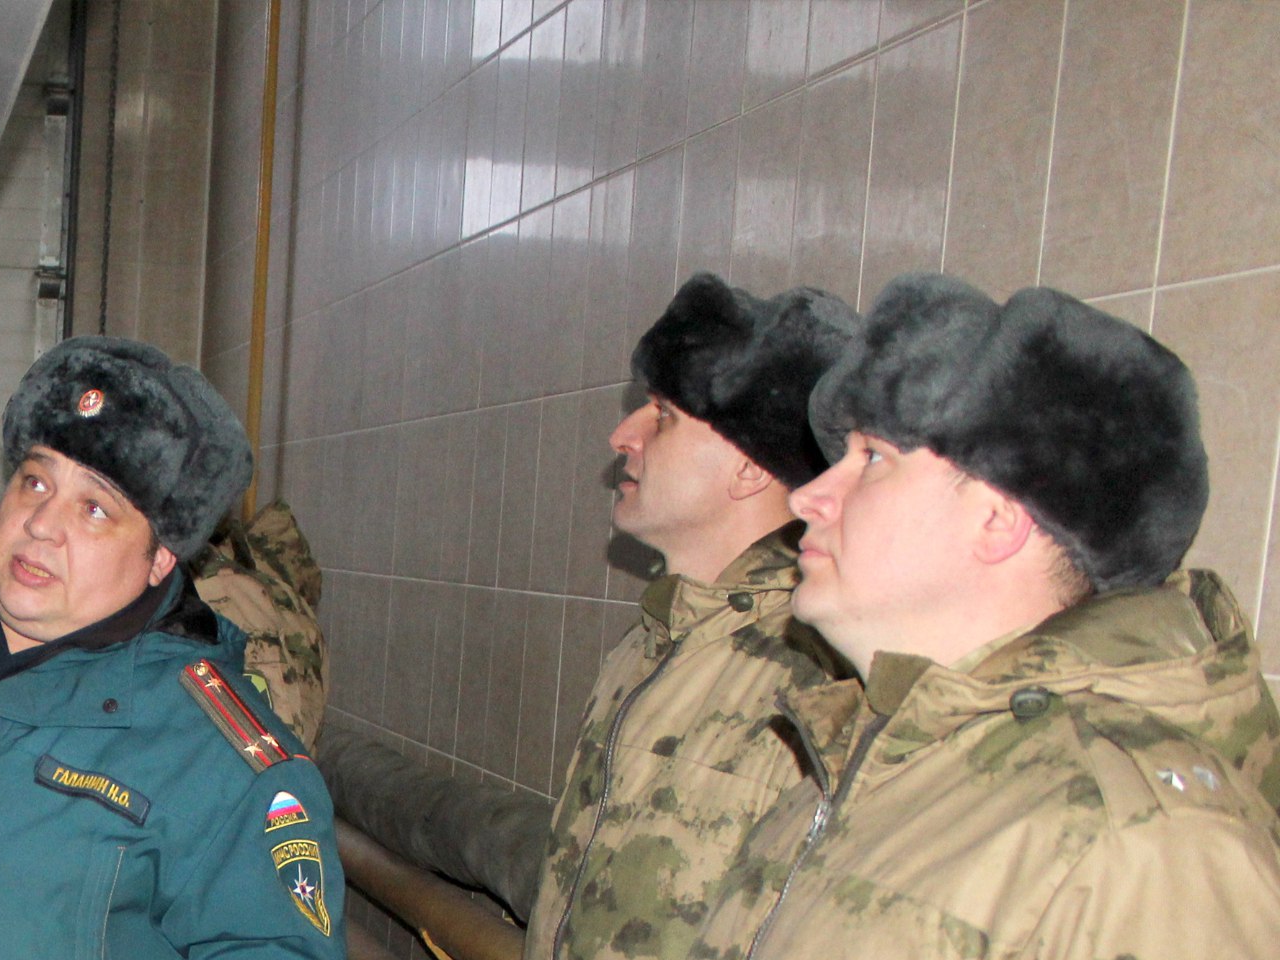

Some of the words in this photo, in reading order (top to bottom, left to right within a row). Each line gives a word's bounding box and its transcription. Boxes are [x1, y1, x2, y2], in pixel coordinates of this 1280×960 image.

[271, 812, 298, 827] РОССИЯ
[274, 847, 291, 864] МЧС
[288, 843, 319, 858] РОССИИ
